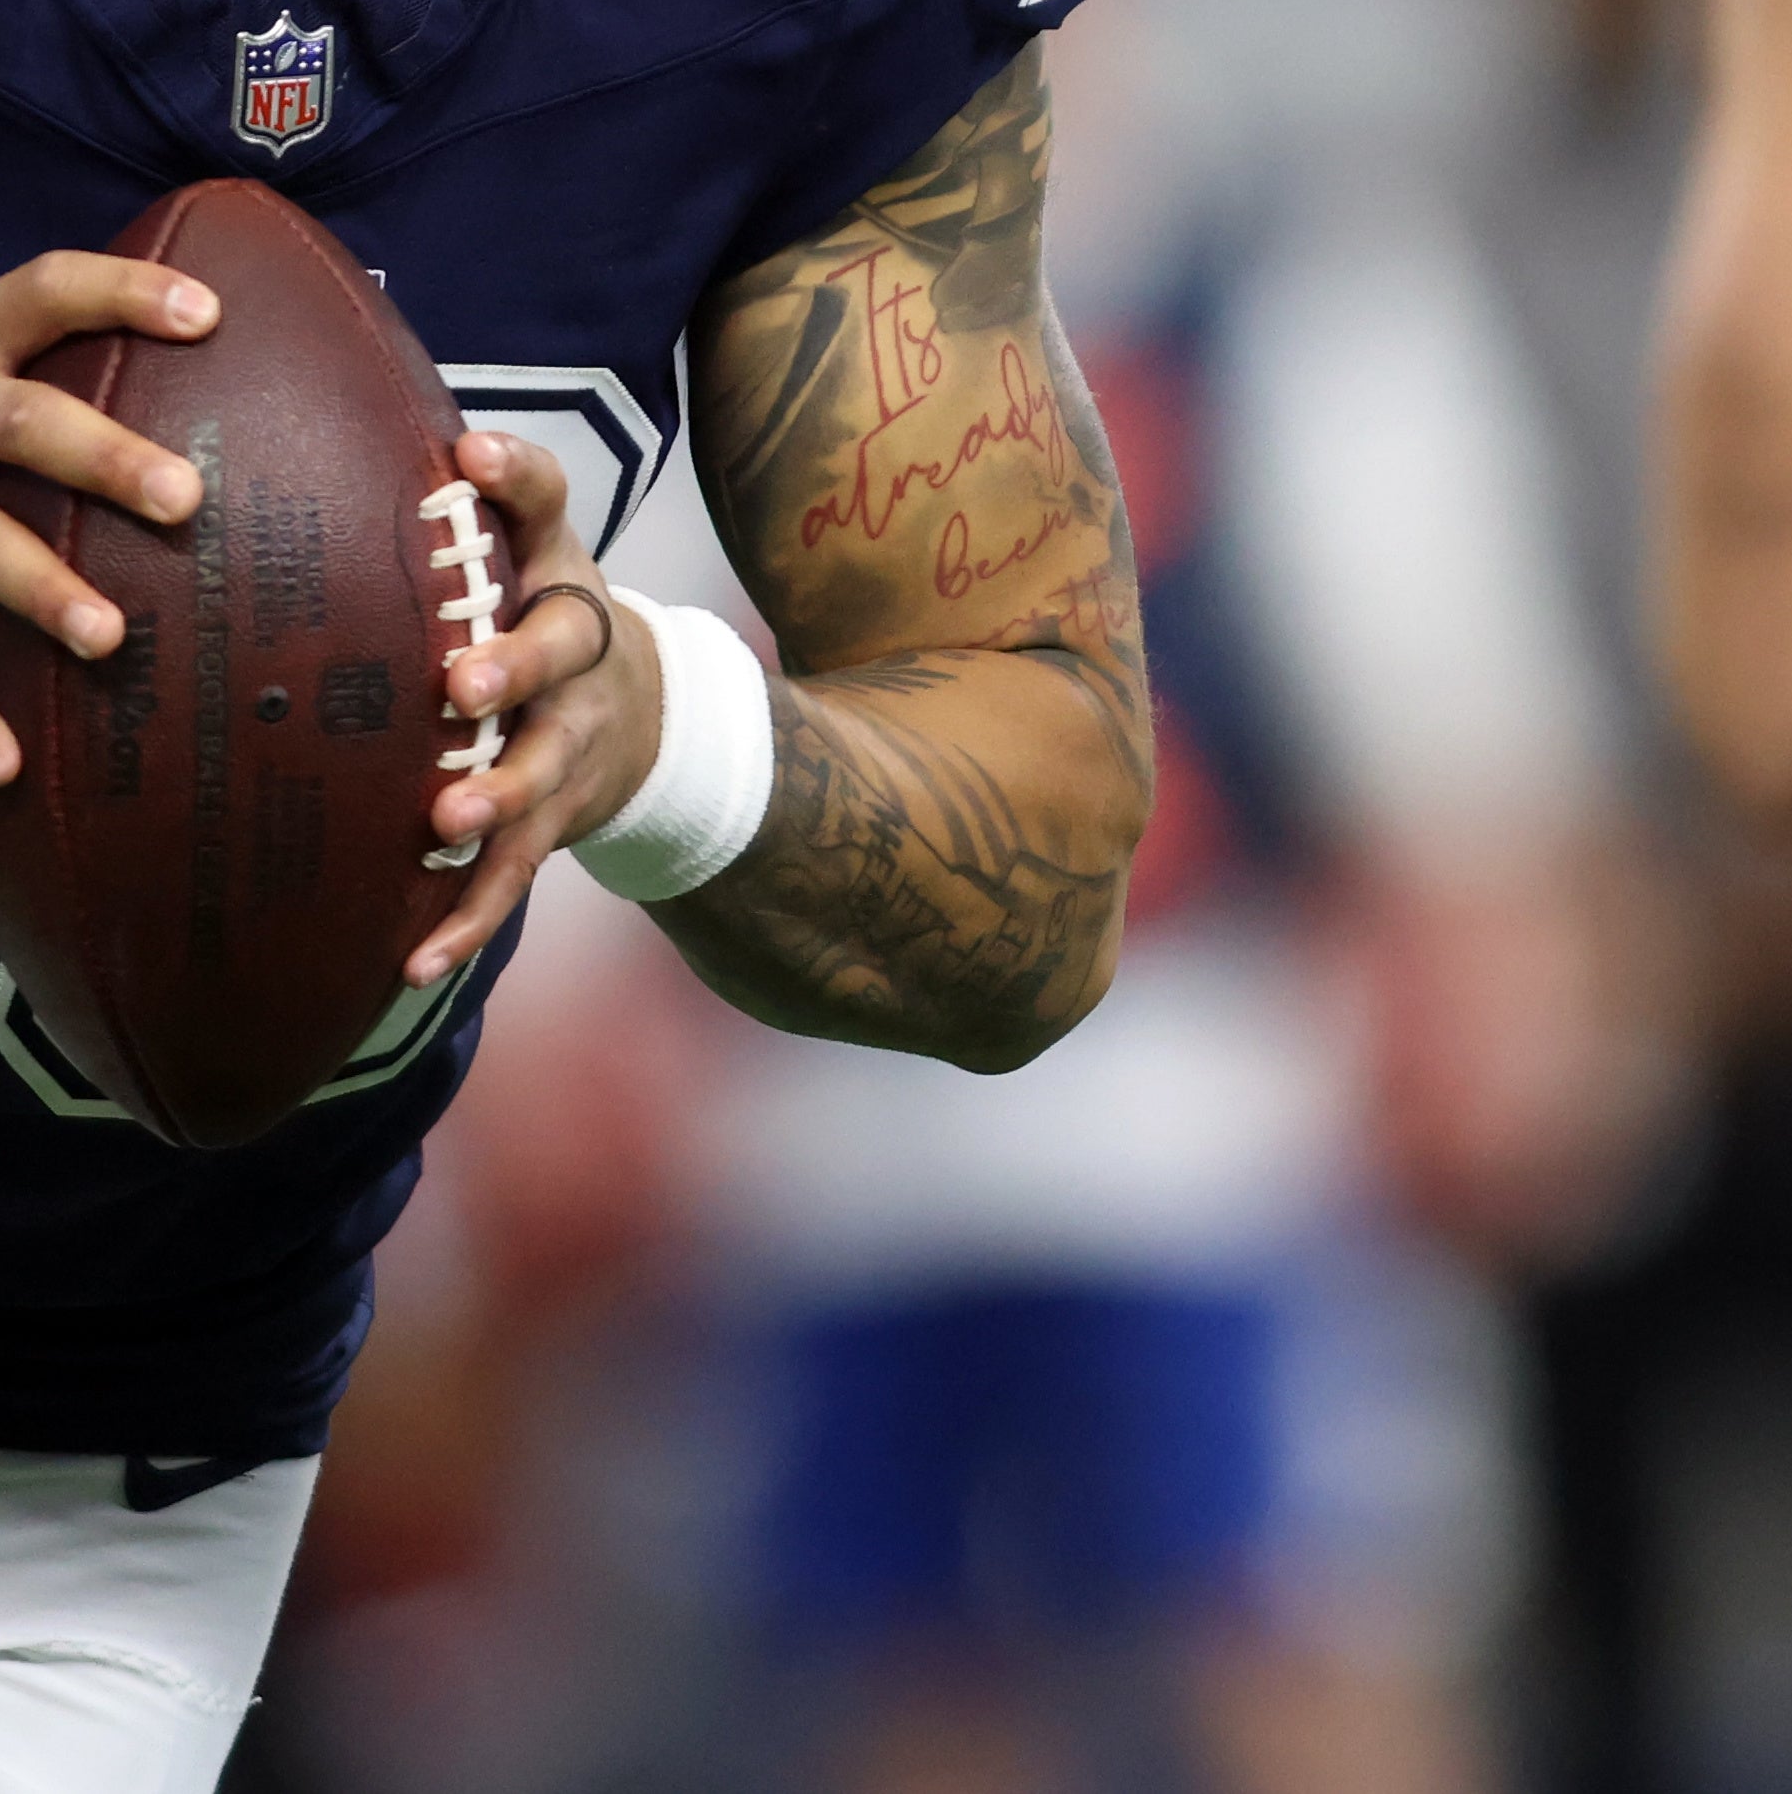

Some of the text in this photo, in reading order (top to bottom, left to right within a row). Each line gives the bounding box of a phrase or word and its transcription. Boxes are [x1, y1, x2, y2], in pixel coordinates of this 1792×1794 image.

[249, 81, 318, 132] NFL
[825, 245, 943, 426] Its
[801, 342, 1065, 542] already
